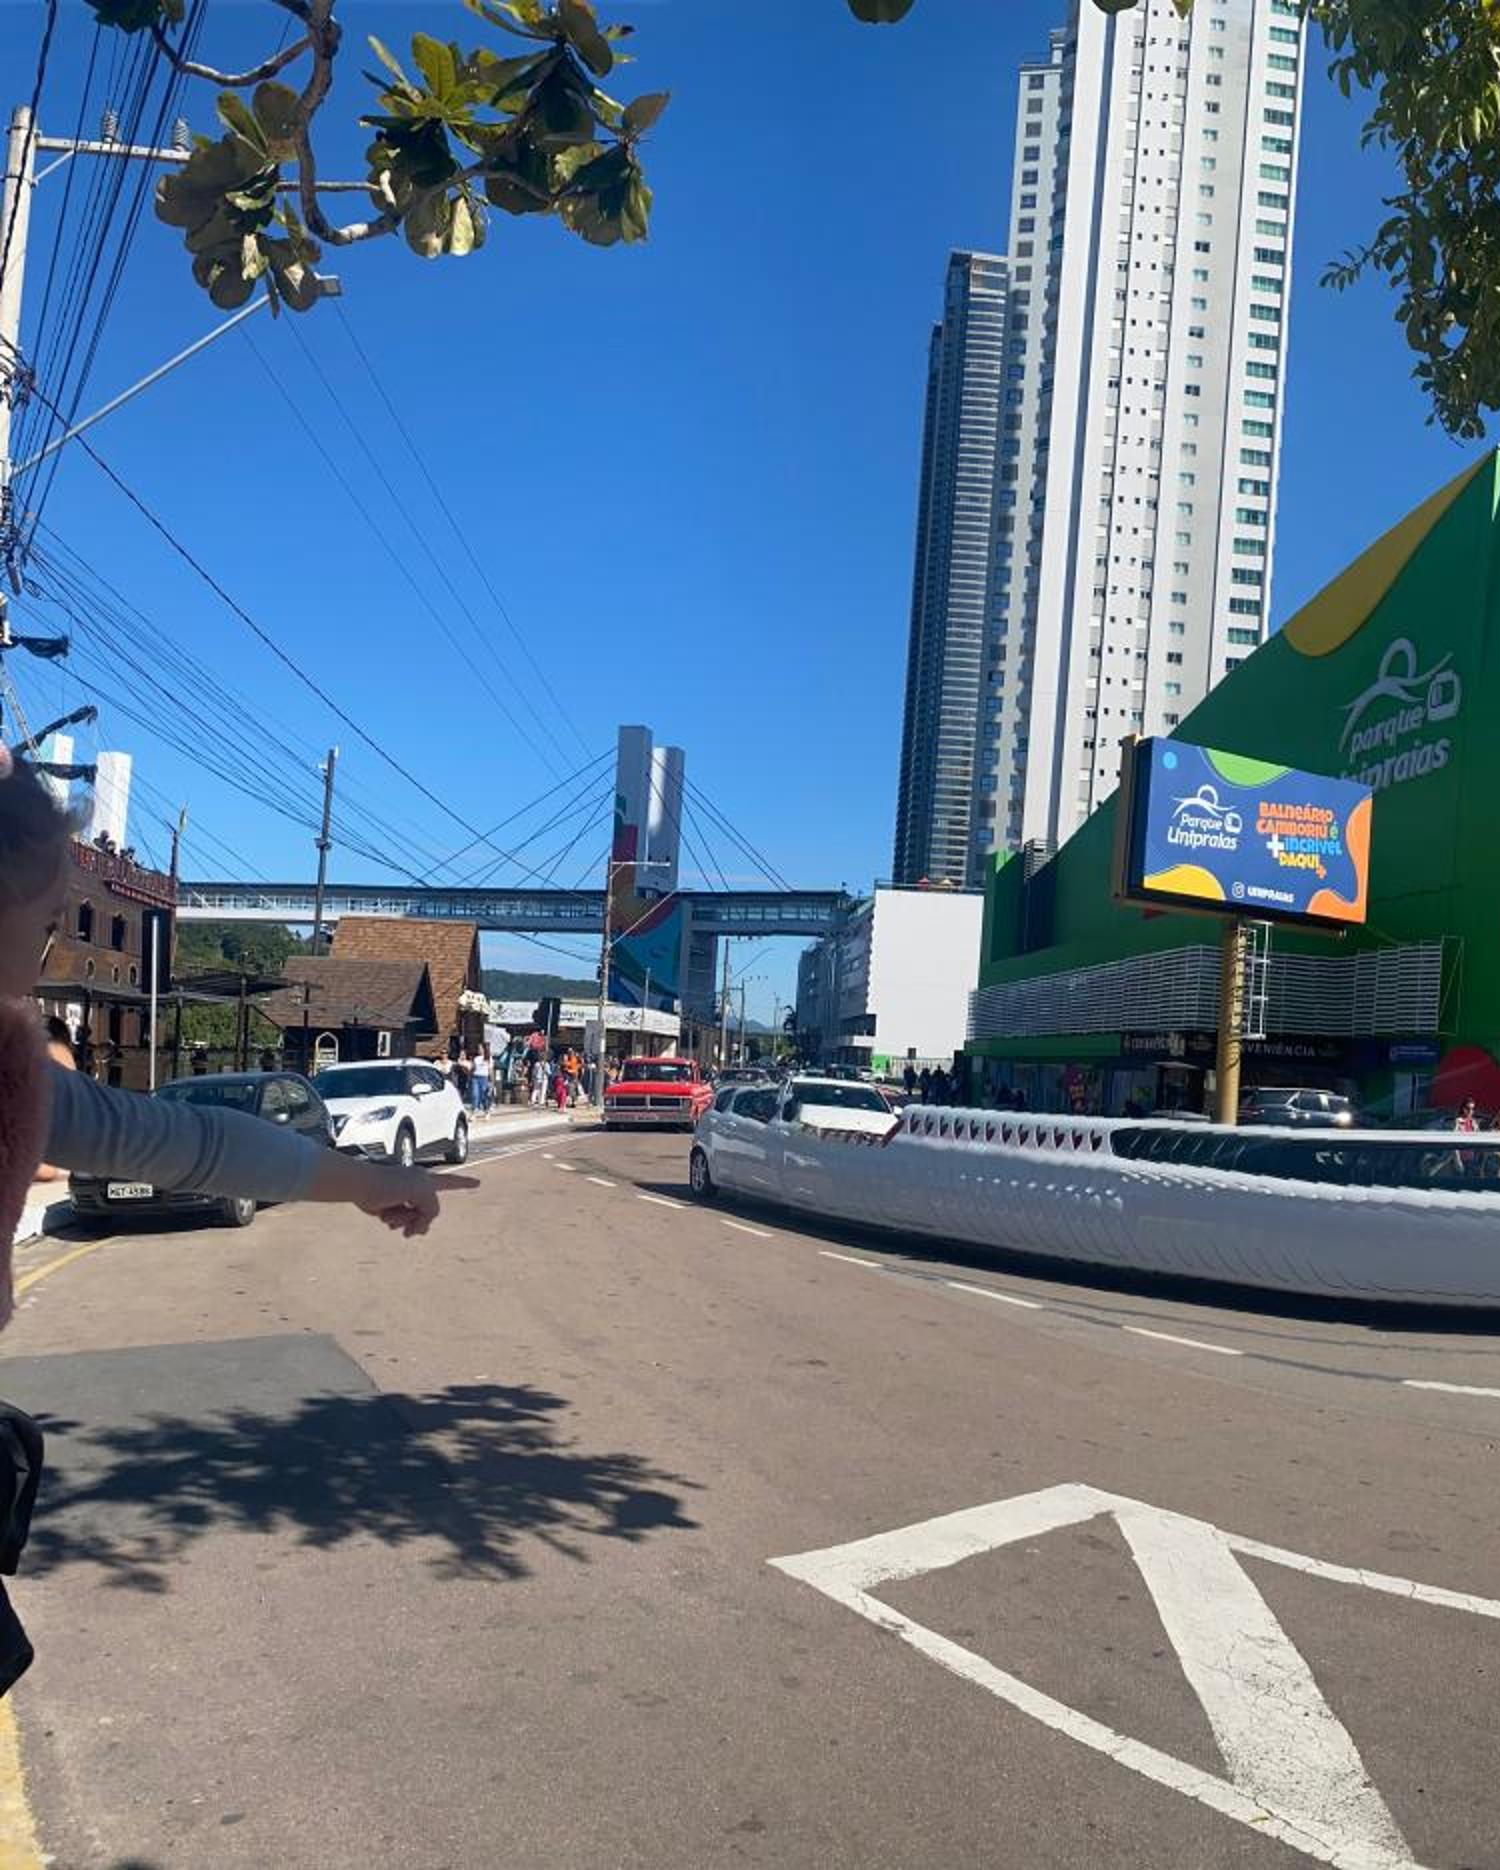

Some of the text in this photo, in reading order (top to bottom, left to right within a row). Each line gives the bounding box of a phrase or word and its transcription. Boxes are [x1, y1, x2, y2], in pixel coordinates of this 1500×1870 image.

[1180, 813, 1223, 832] Parque
[1168, 826, 1237, 850] Unipraias
[1279, 852, 1320, 870] DAQUI
